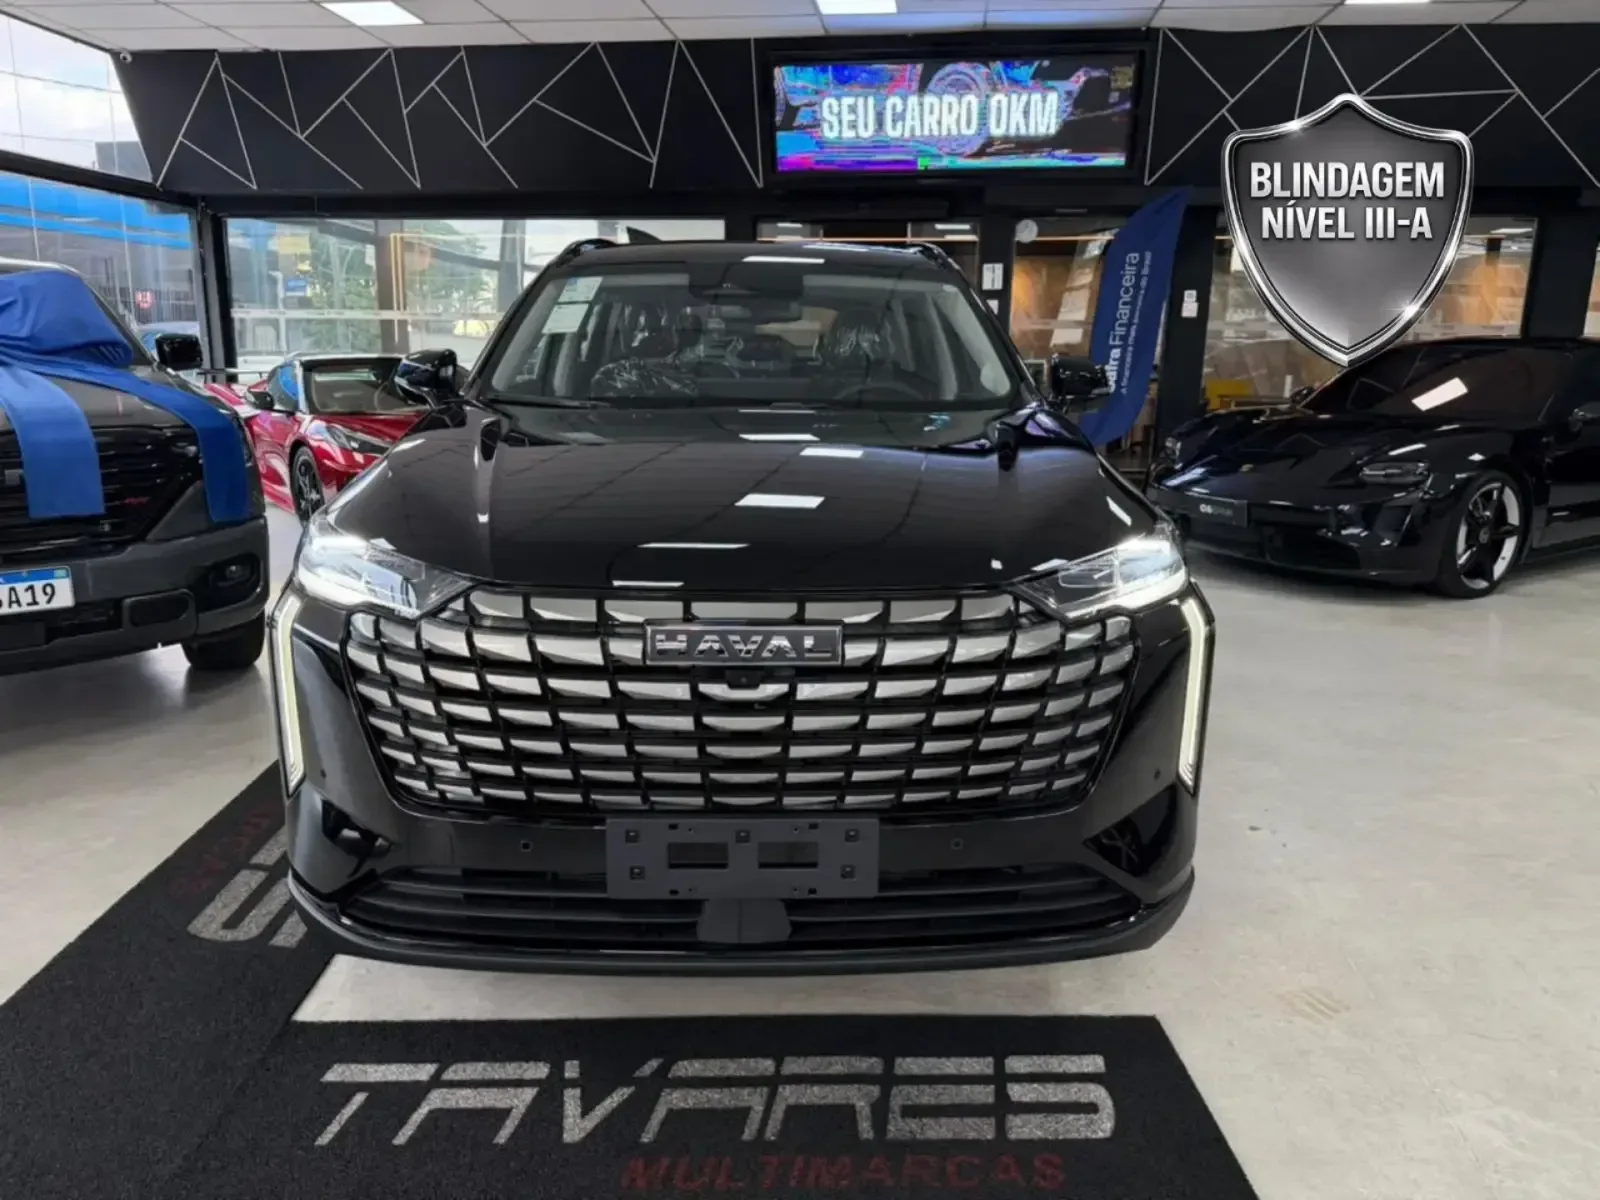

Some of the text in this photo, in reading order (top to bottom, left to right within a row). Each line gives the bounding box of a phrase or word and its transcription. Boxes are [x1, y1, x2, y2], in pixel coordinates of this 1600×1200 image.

[820, 95, 876, 140] SEU
[884, 92, 978, 138] CARRO
[1109, 253, 1140, 345] Financeira
[0, 582, 56, 610] A19
[655, 634, 832, 658] HAVAL
[314, 1055, 1115, 1145] TAVARES
[620, 1152, 1066, 1193] MULTIMARCAS
